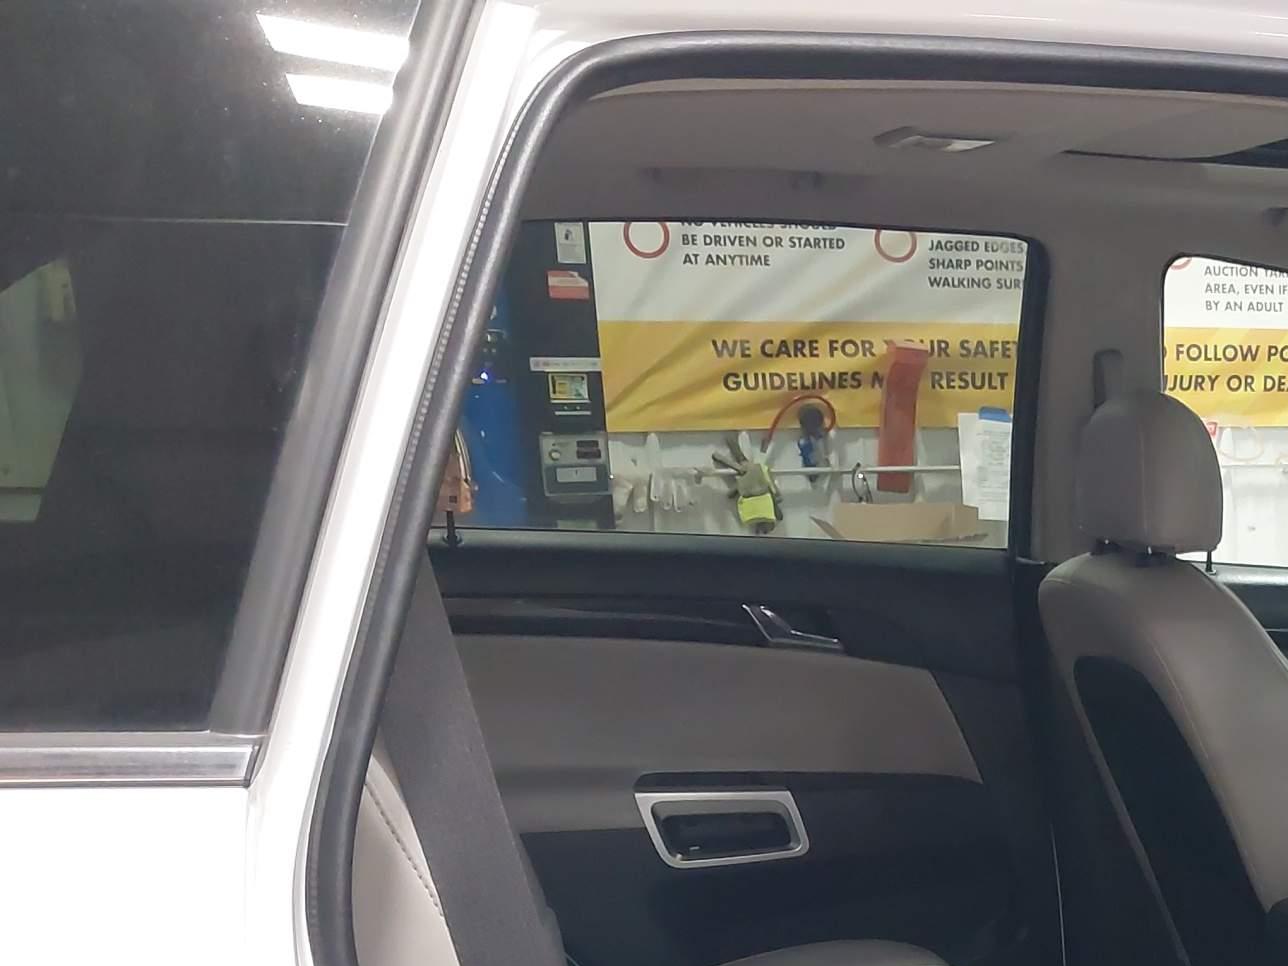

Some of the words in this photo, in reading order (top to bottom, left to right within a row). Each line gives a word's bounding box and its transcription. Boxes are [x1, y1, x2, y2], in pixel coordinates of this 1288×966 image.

[681, 234, 698, 246] BE
[703, 235, 757, 248] DRIVEN
[763, 236, 784, 249] OR
[789, 237, 846, 250] STARTED
[928, 240, 979, 252] JAGGED
[984, 241, 1024, 253] EDGES
[683, 254, 699, 265] AT
[705, 254, 771, 267] ANYTIME
[928, 258, 972, 271] SHARP
[976, 259, 1024, 272] POINTS
[1204, 265, 1258, 277] AUCTION
[928, 276, 992, 289] WALKING
[996, 277, 1024, 290] SUR
[1204, 283, 1240, 295] AREA,
[1244, 284, 1274, 295] EVEN
[1279, 285, 1288, 295] IF
[1205, 300, 1220, 312] BY
[1224, 300, 1243, 312] AN
[1247, 301, 1284, 312] ADULT
[712, 339, 752, 359] WE
[760, 339, 820, 358] CARE
[829, 339, 875, 358] FOR
[883, 338, 950, 358] UR
[959, 340, 1018, 359] SAFE
[1175, 343, 1261, 362] FOLLOW
[722, 371, 862, 391] GUIDELINES
[931, 372, 1009, 390] RESULT
[1226, 375, 1256, 392] OR
